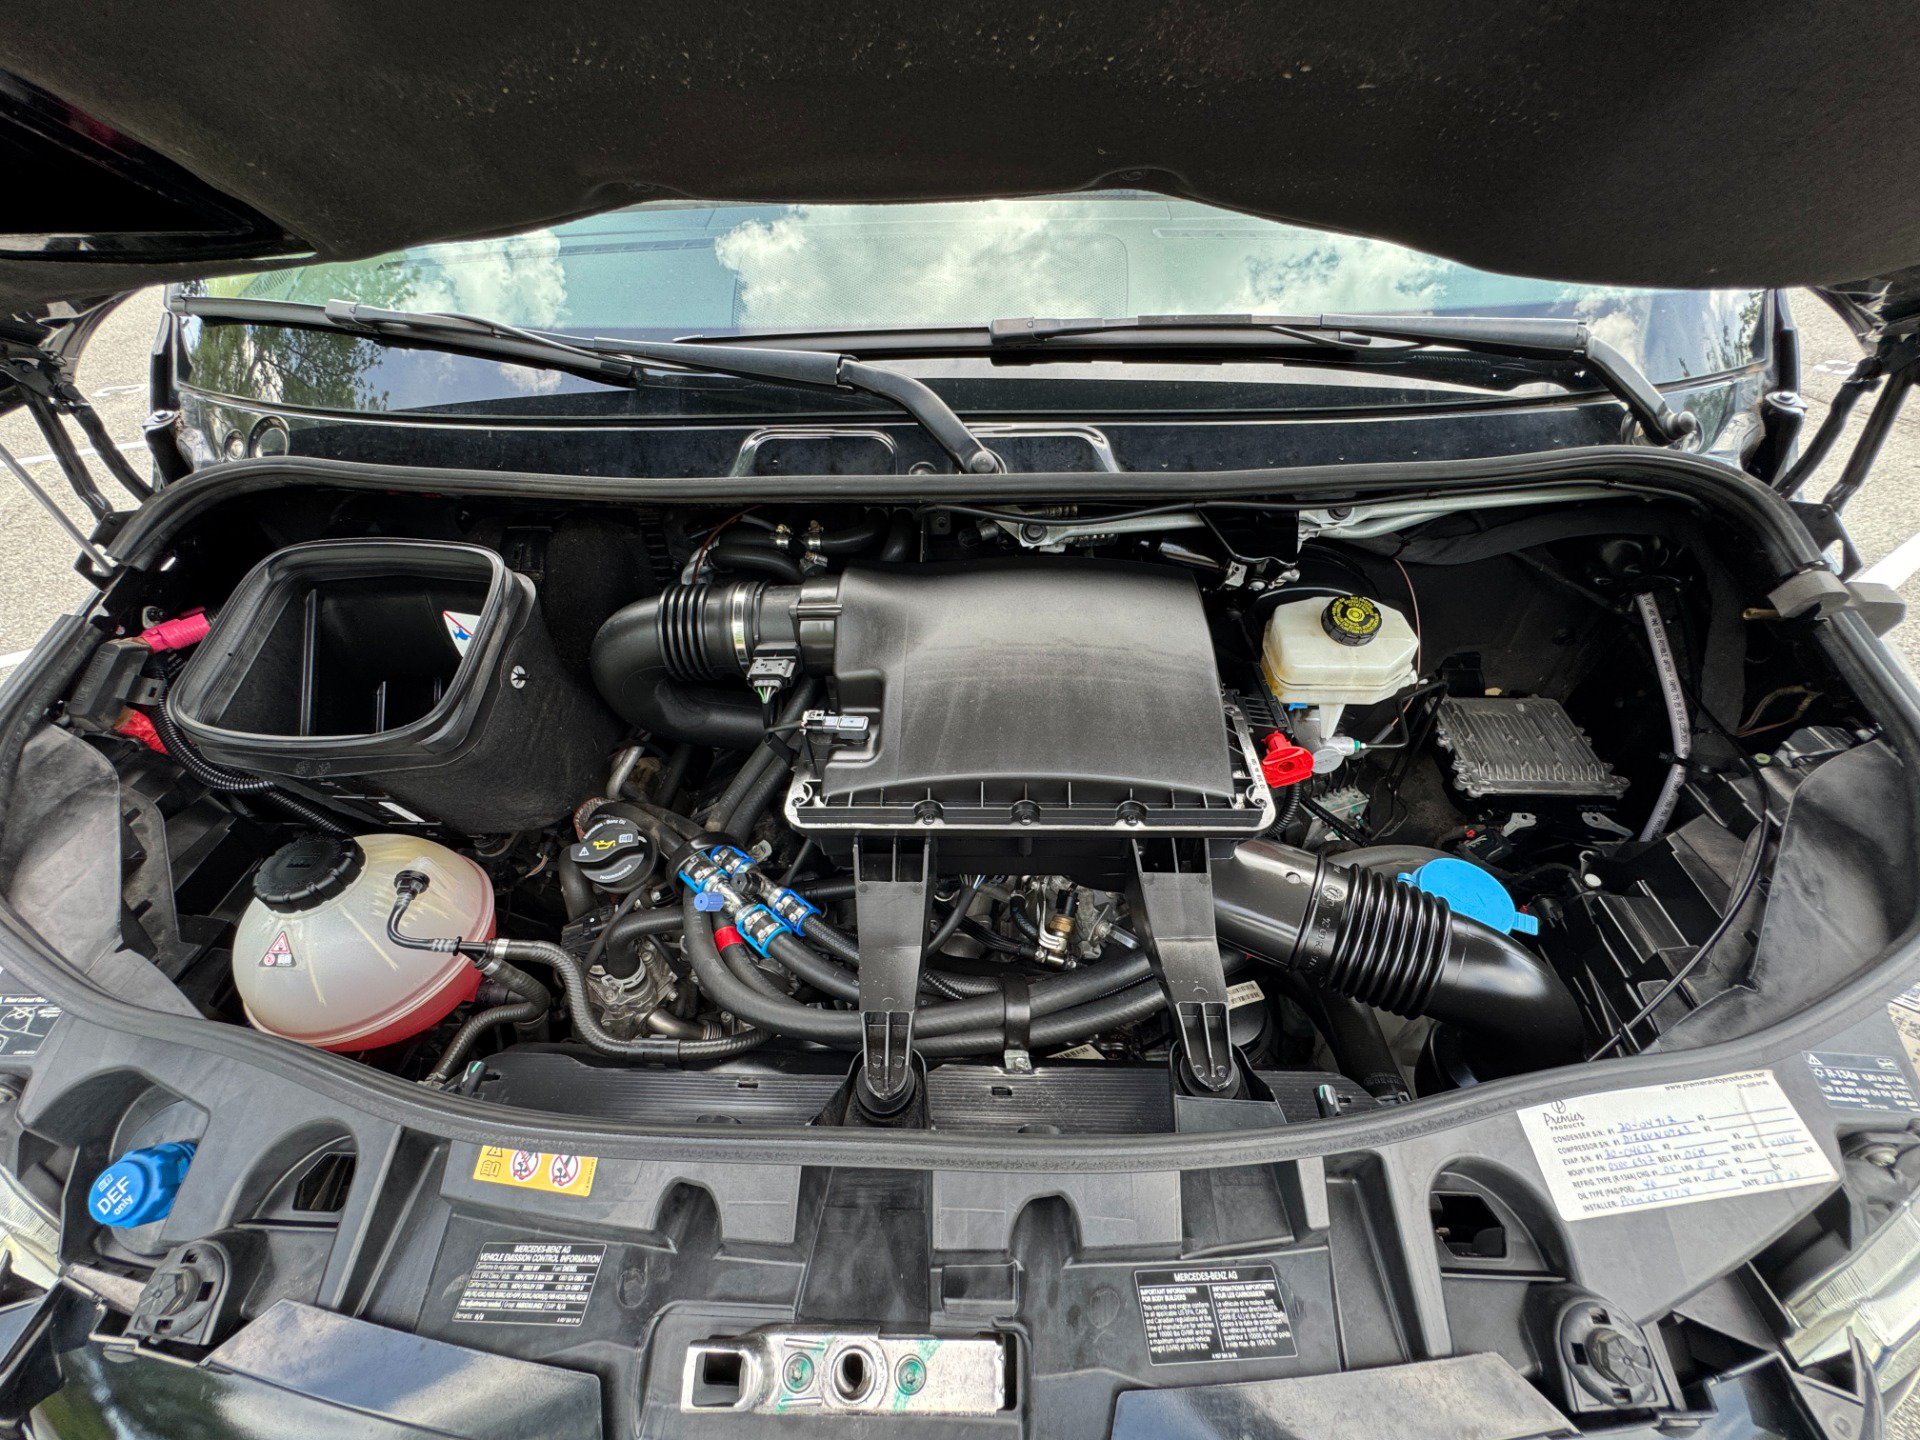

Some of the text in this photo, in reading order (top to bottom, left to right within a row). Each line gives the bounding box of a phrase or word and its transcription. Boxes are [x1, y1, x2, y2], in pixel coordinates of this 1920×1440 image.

[599, 864, 632, 880] recommended
[1824, 1068, 1860, 1080] R-134a
[1664, 1072, 1766, 1091] www.premierautoproducts.net
[1543, 1112, 1585, 1126] Premier
[1550, 1122, 1585, 1131] PRODUCTS
[1552, 1131, 1590, 1143] CONDENSER
[1557, 1142, 1597, 1154] COMPRESSOR
[1596, 1176, 1611, 1184] TYPE
[97, 1175, 130, 1215] DEF
[1588, 1190, 1603, 1198] TYPE
[113, 1194, 133, 1215] only
[479, 1252, 504, 1260] VEHICLE
[504, 1253, 531, 1261] EMISSION
[559, 1254, 600, 1263] INFORMATION
[1173, 1270, 1237, 1281] MERCEDES-BENZ AG
